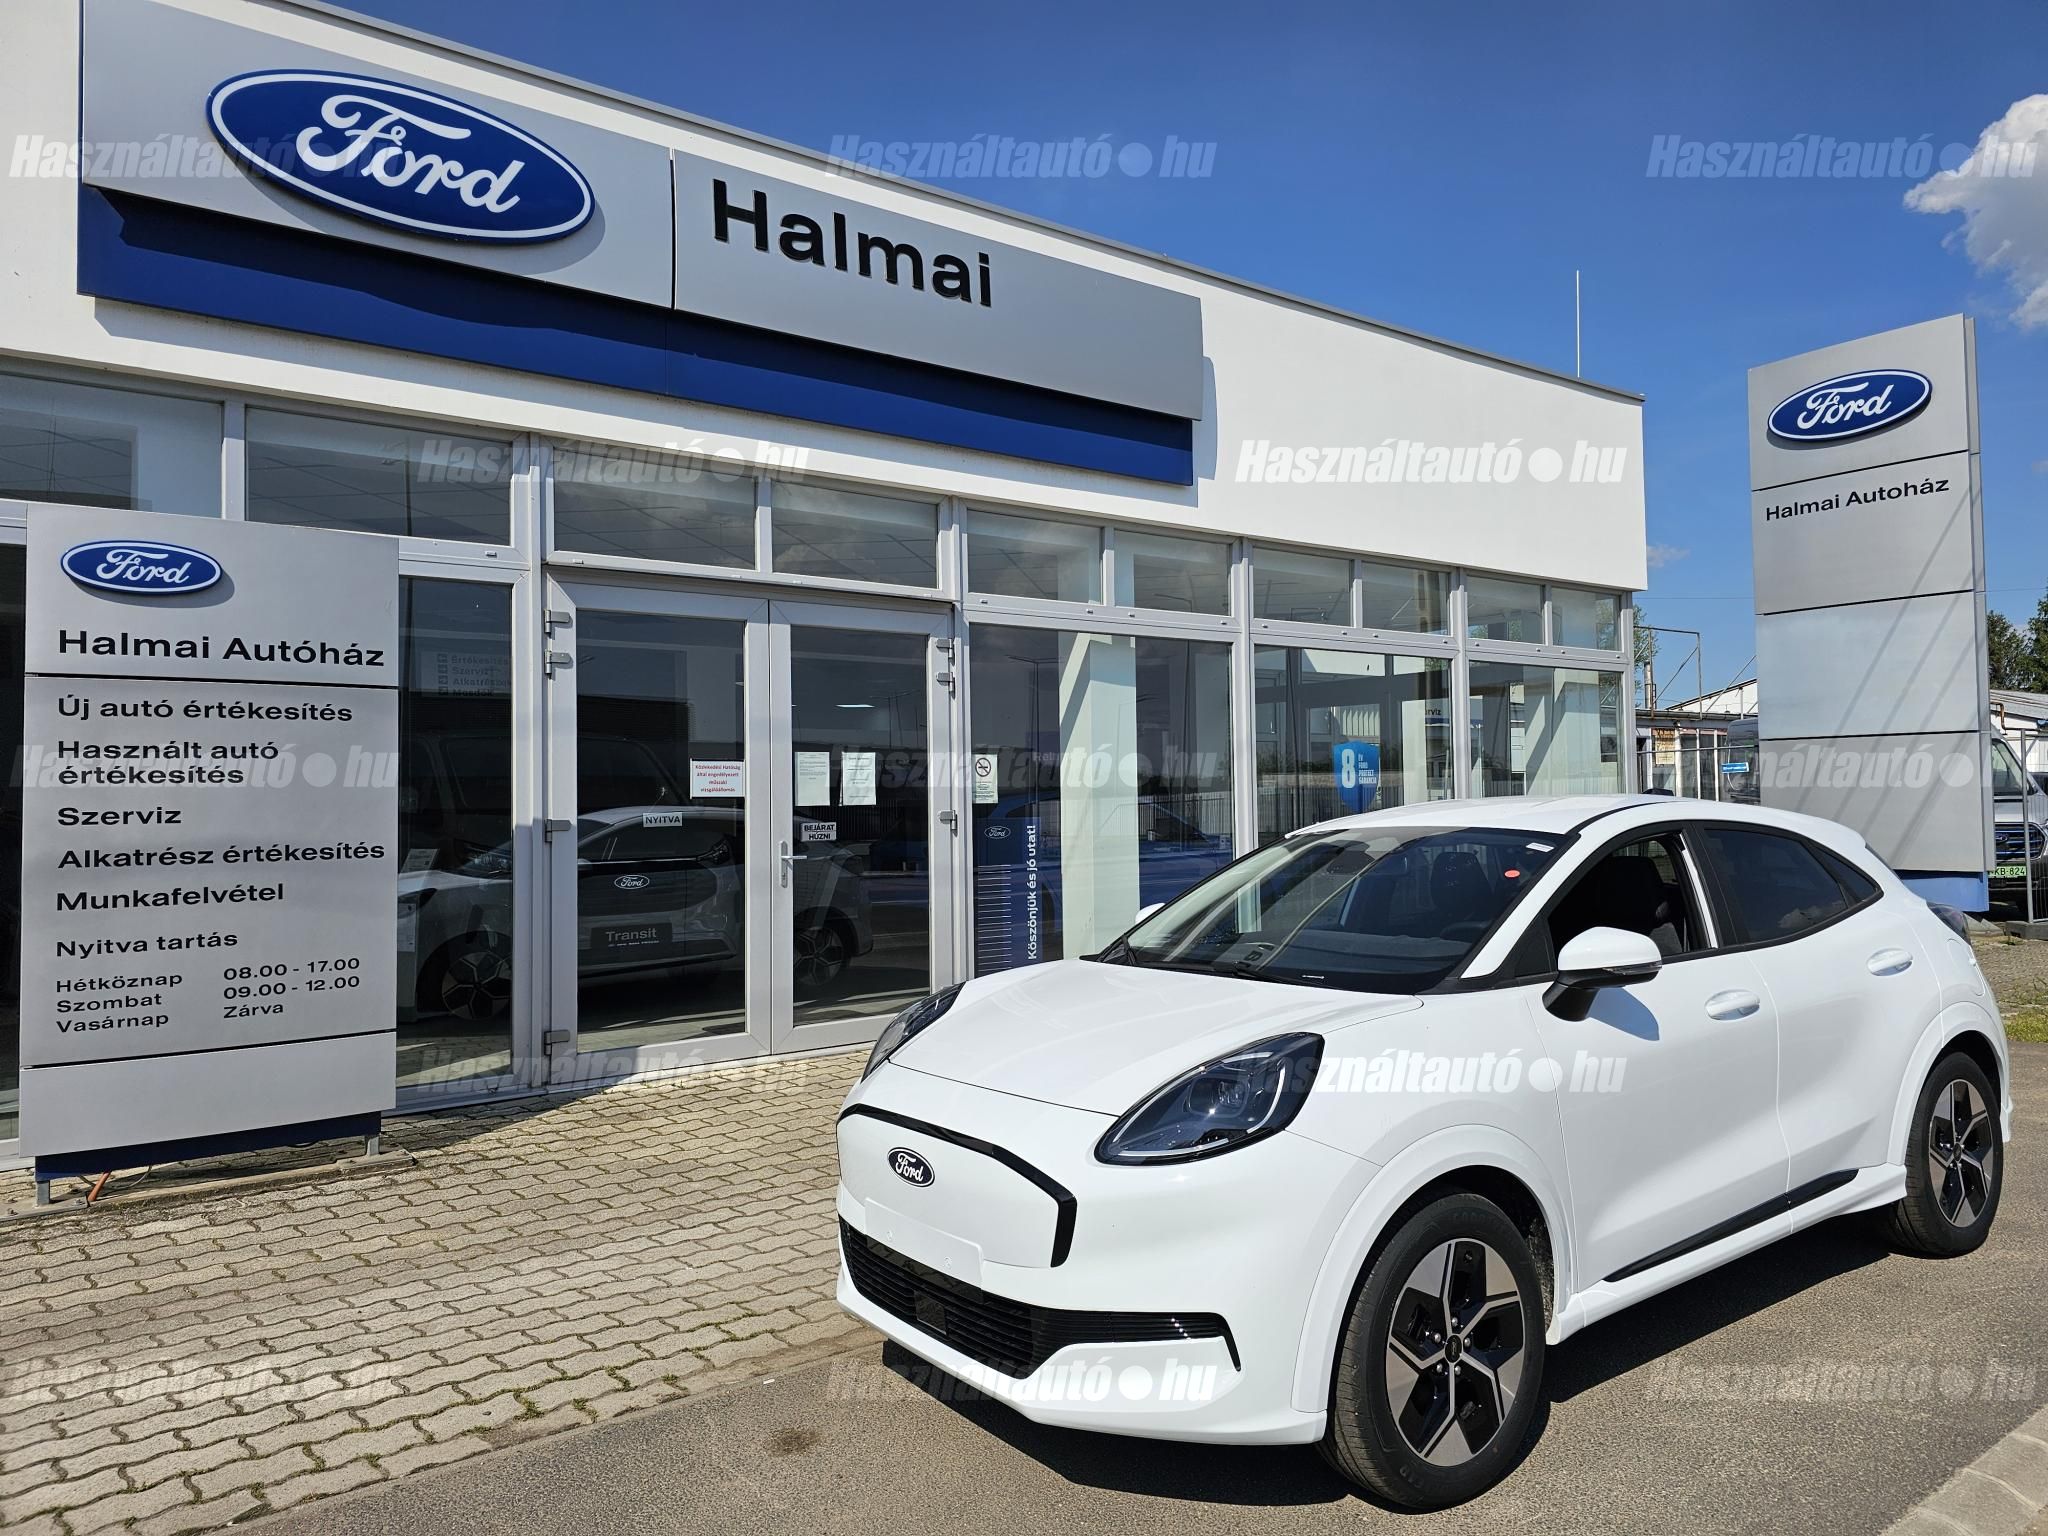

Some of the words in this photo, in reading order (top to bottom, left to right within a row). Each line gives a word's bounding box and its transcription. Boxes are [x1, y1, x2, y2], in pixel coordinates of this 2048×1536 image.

[296, 94, 525, 213] Ford
[713, 179, 992, 307] Halmai
[1797, 382, 1894, 429] Ford
[1767, 494, 1839, 521] Halmai
[1846, 478, 1949, 506] Autoház
[97, 549, 192, 584] Ford
[60, 630, 209, 658] Halmai
[223, 638, 384, 666] Autóház
[59, 695, 89, 720] Új
[100, 700, 173, 717] autó
[183, 700, 352, 721] értékesítés
[59, 741, 201, 759] Használt
[211, 742, 278, 759] autó
[59, 766, 243, 784] értékesítés
[1341, 748, 1356, 789] 8
[58, 807, 181, 825] Szerviz
[645, 815, 681, 824] NYITVA
[804, 823, 835, 832] BEJÁRAT
[989, 827, 1006, 837] Ford
[1026, 825, 1036, 857] utat!
[58, 847, 213, 868] Alkatrész
[223, 842, 384, 863] értékesítés
[1026, 858, 1038, 872] jó
[621, 876, 644, 887] Ford
[1027, 873, 1037, 889] és
[57, 883, 283, 910] Munkafelvétel
[605, 928, 657, 942] Transit
[1027, 891, 1038, 960] Köszönjük
[57, 940, 147, 959] Nyitva
[157, 932, 237, 950] tartás
[57, 975, 182, 992] Hétköznap
[224, 964, 287, 980] 08.00
[308, 958, 359, 972] 17.00
[57, 994, 161, 1013] Szombat
[224, 983, 286, 999] 09.00
[306, 976, 359, 991] 12.00
[56, 1015, 168, 1032] Vasárnap
[224, 1004, 283, 1018] Zárva
[894, 1153, 924, 1182] Ford
